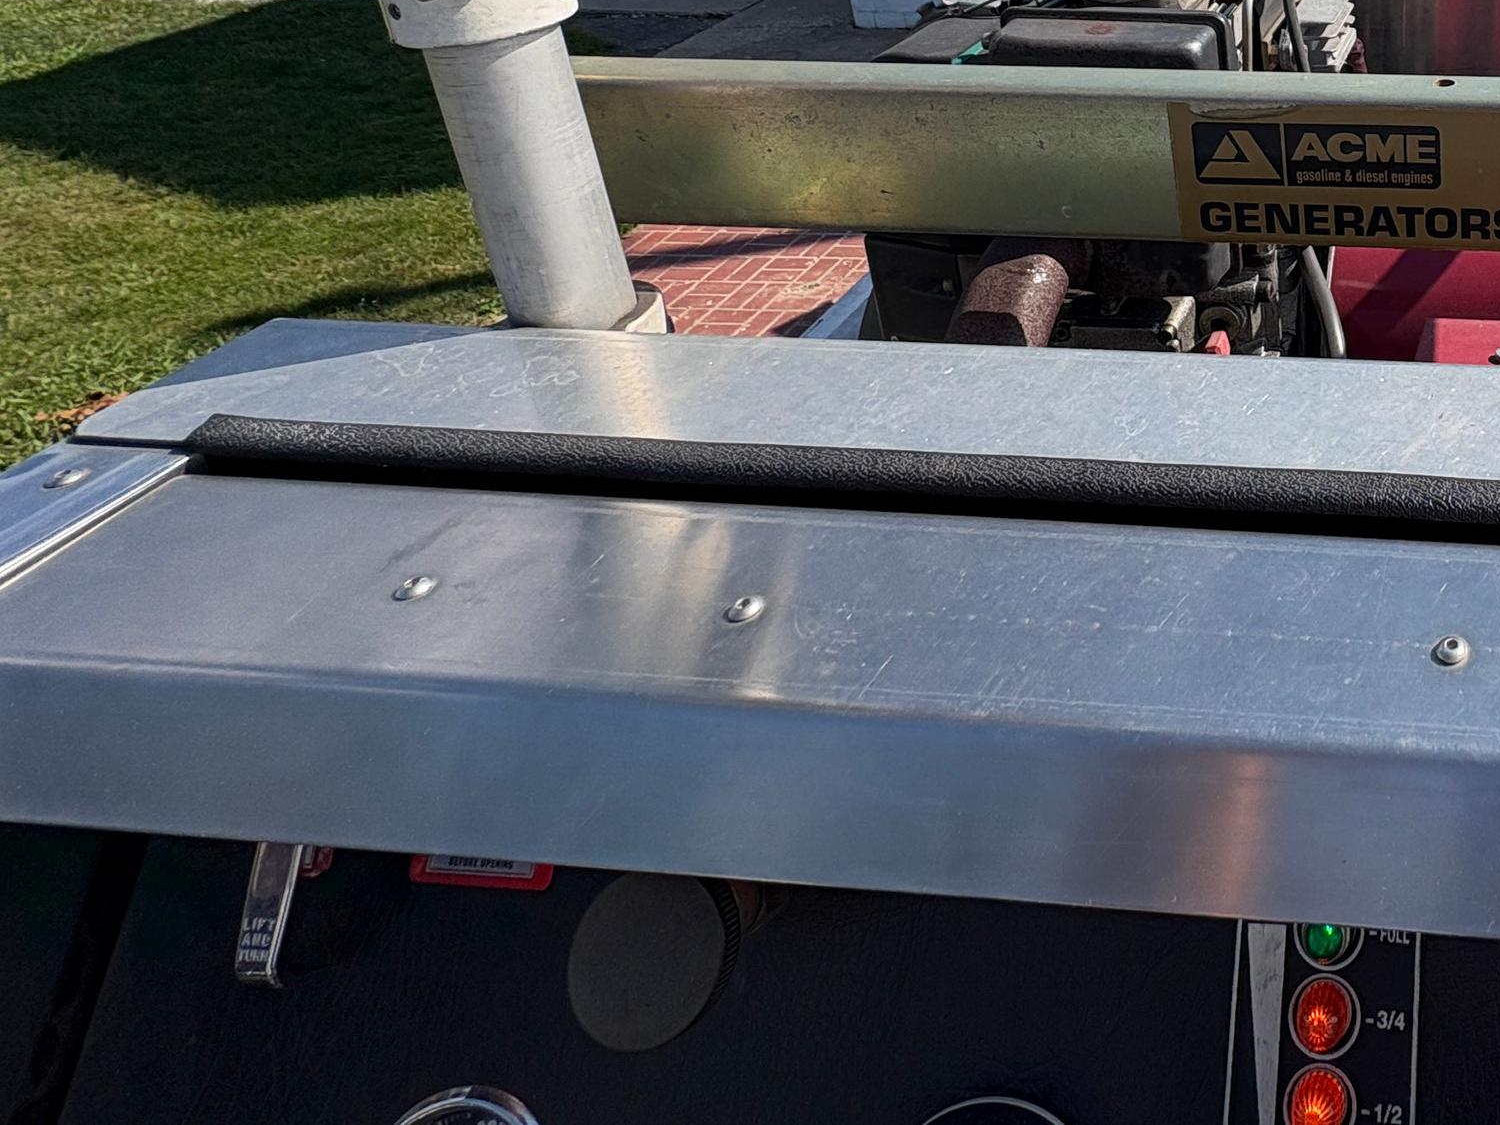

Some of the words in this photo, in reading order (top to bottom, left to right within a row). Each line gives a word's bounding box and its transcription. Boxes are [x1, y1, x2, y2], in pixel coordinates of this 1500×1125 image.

[1291, 132, 1437, 164] ACME
[1296, 168, 1341, 184] gasoline
[1344, 169, 1353, 182] &
[1355, 169, 1388, 184] diesel
[1390, 171, 1434, 187] engines
[243, 917, 276, 931] LIFT
[240, 932, 271, 947] AND
[238, 948, 270, 962] TURN
[1376, 1010, 1406, 1031] 3/4
[1374, 1103, 1403, 1125] 1/2
